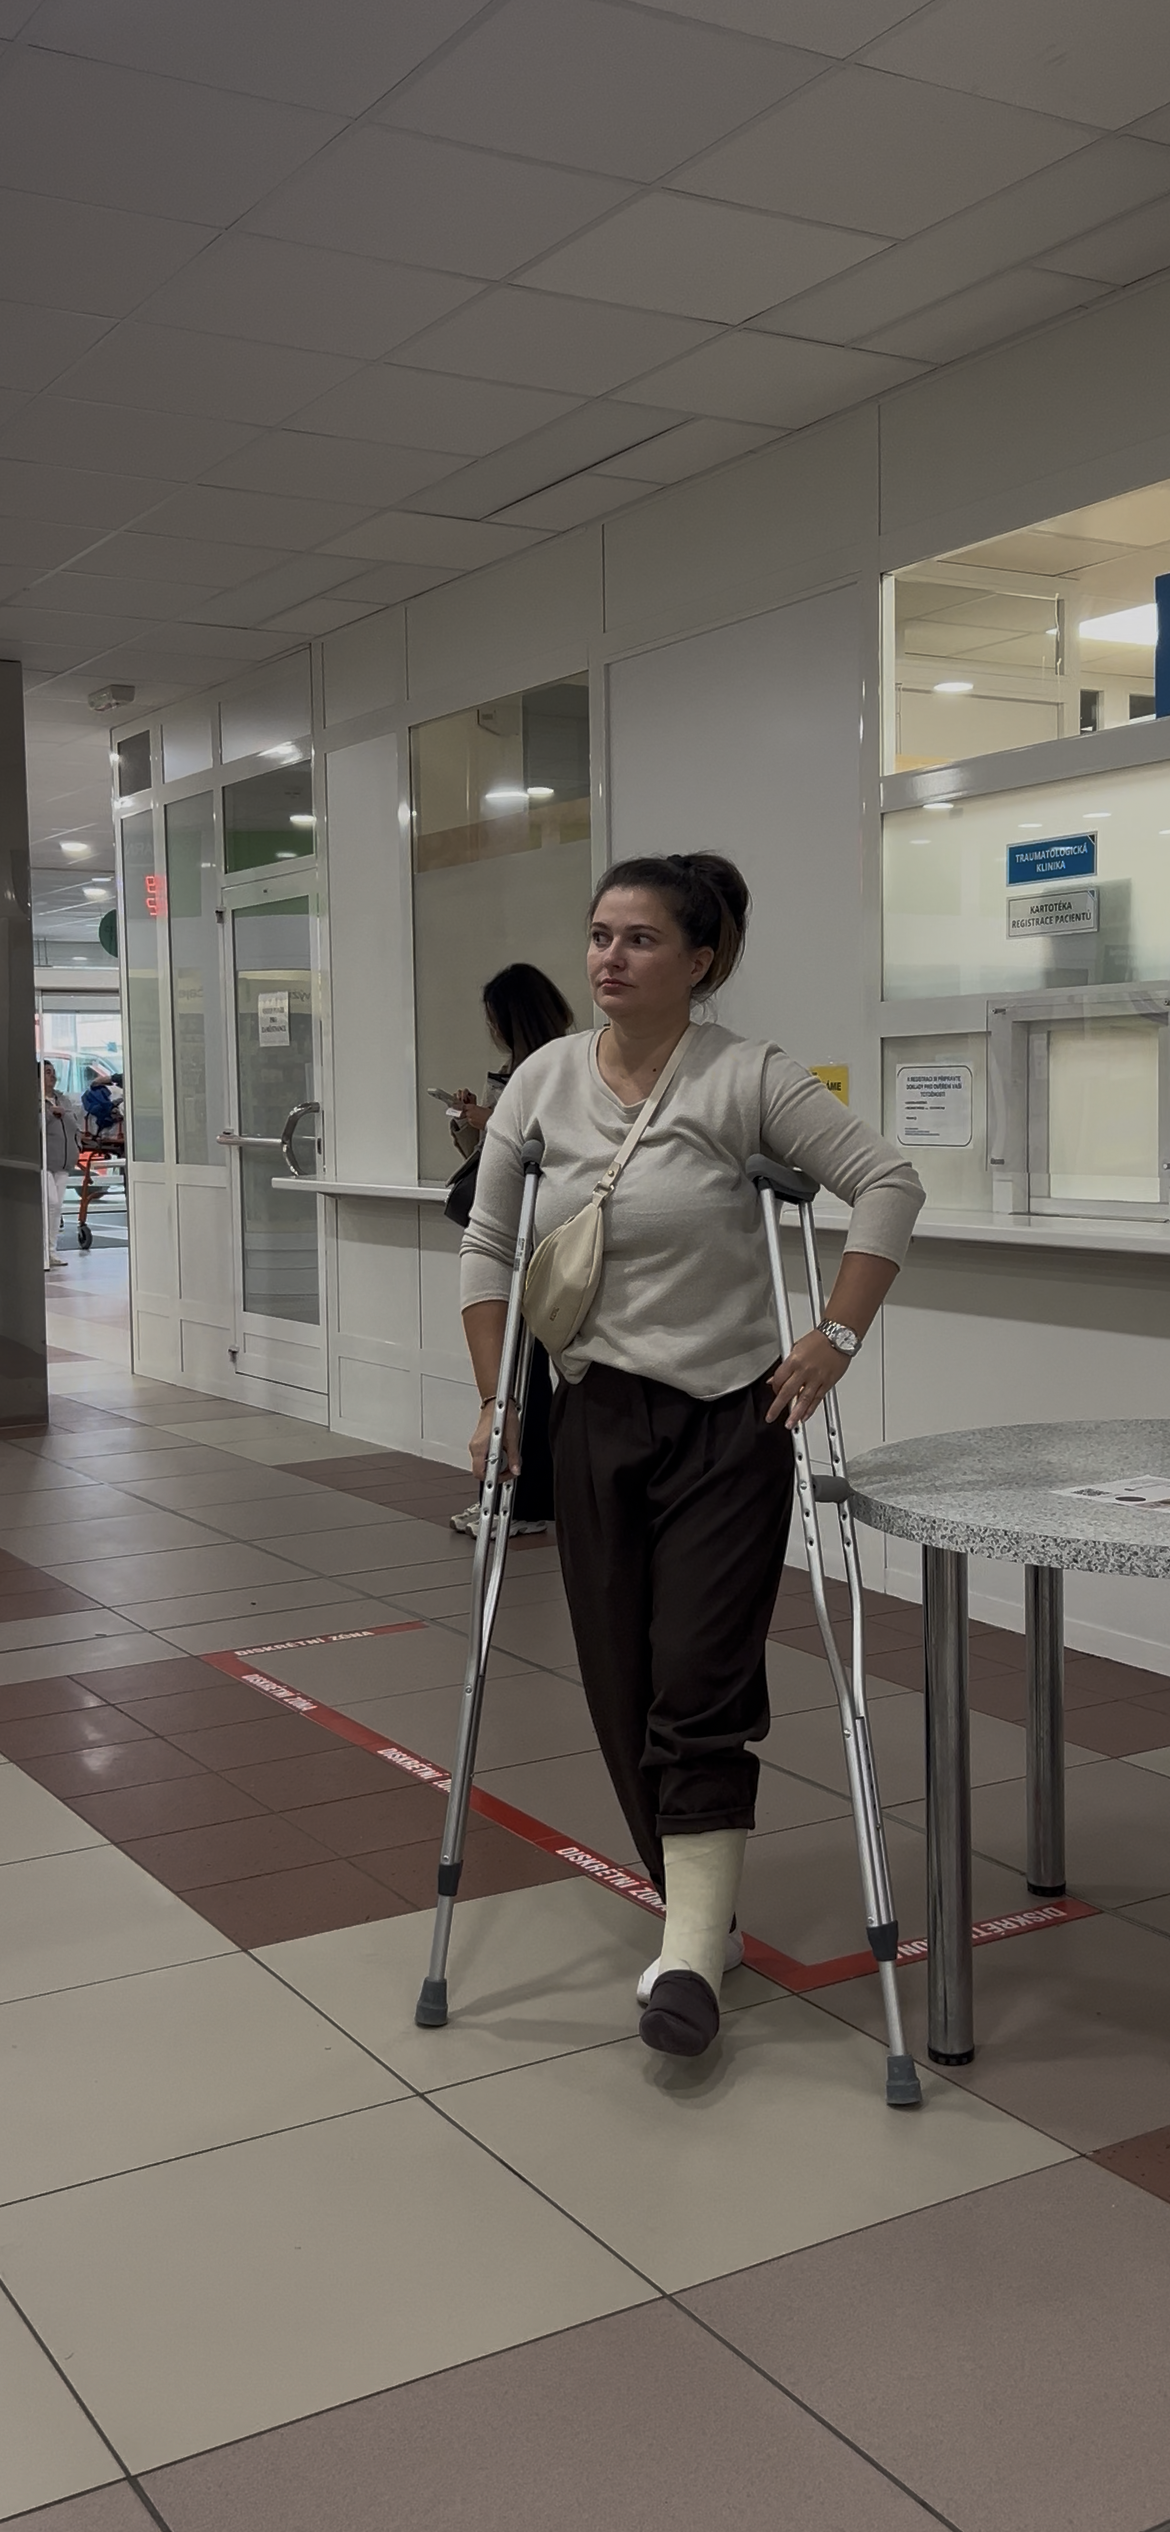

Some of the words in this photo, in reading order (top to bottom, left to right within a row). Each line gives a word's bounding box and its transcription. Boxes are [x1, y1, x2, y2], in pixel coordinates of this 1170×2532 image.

[1015, 842, 1088, 863] TRAUMATOLOGICKÁ
[1036, 860, 1066, 872] KLINIKA
[1012, 915, 1053, 928] REGISTRACE
[1055, 908, 1092, 924] PACIENTŮ
[1030, 900, 1072, 914] KARTOTÉKA
[234, 1637, 326, 1656] DISKRÉTNÍ
[328, 1631, 375, 1642] ZÓNA
[241, 1673, 300, 1699] DISKRÉTNÍ
[377, 1747, 449, 1780] DISKRÉTNÍ
[555, 1846, 646, 1889] DISKRÉTNÍ
[972, 1906, 1068, 1938] DISKRÉT
